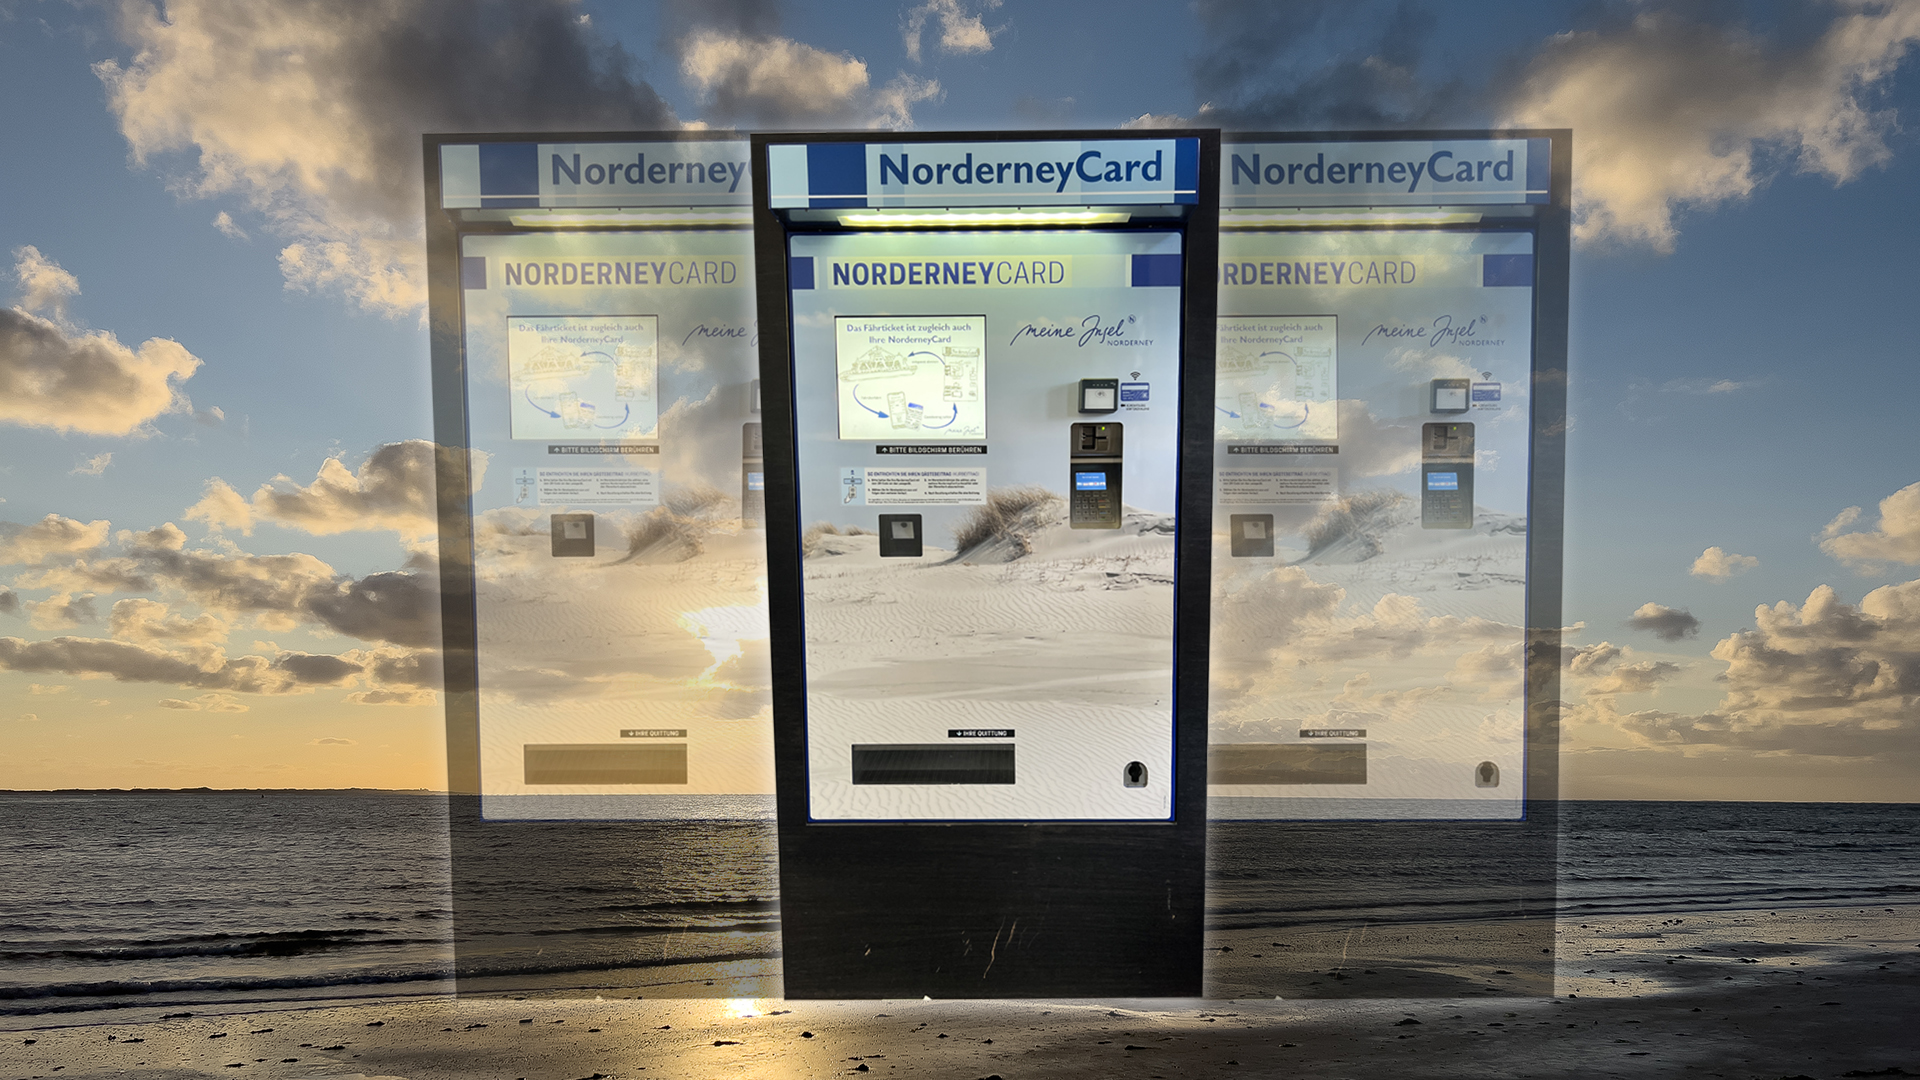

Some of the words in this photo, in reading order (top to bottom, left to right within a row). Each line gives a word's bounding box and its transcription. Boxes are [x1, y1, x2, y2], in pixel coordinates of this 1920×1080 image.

[552, 153, 752, 193] Norderney
[879, 150, 1162, 193] NorderneyCard
[1230, 150, 1514, 193] NorderneyCard
[505, 261, 736, 286] NORDERNEYCARD
[833, 261, 1064, 286] NORDERNEYCARD
[1218, 261, 1416, 285] RDERNEYCARD
[682, 324, 747, 346] meine
[846, 324, 862, 332] Das
[864, 324, 904, 332] Fährticket
[906, 324, 916, 332] ist
[918, 323, 950, 333] zugleich
[952, 323, 972, 331] auch
[1010, 324, 1075, 346] meine
[1361, 324, 1426, 346] meine
[869, 336, 886, 344] Ihre
[888, 336, 952, 345] NorderneyCard
[1220, 336, 1237, 344] Ihre
[1240, 336, 1303, 345] NorderneyCard
